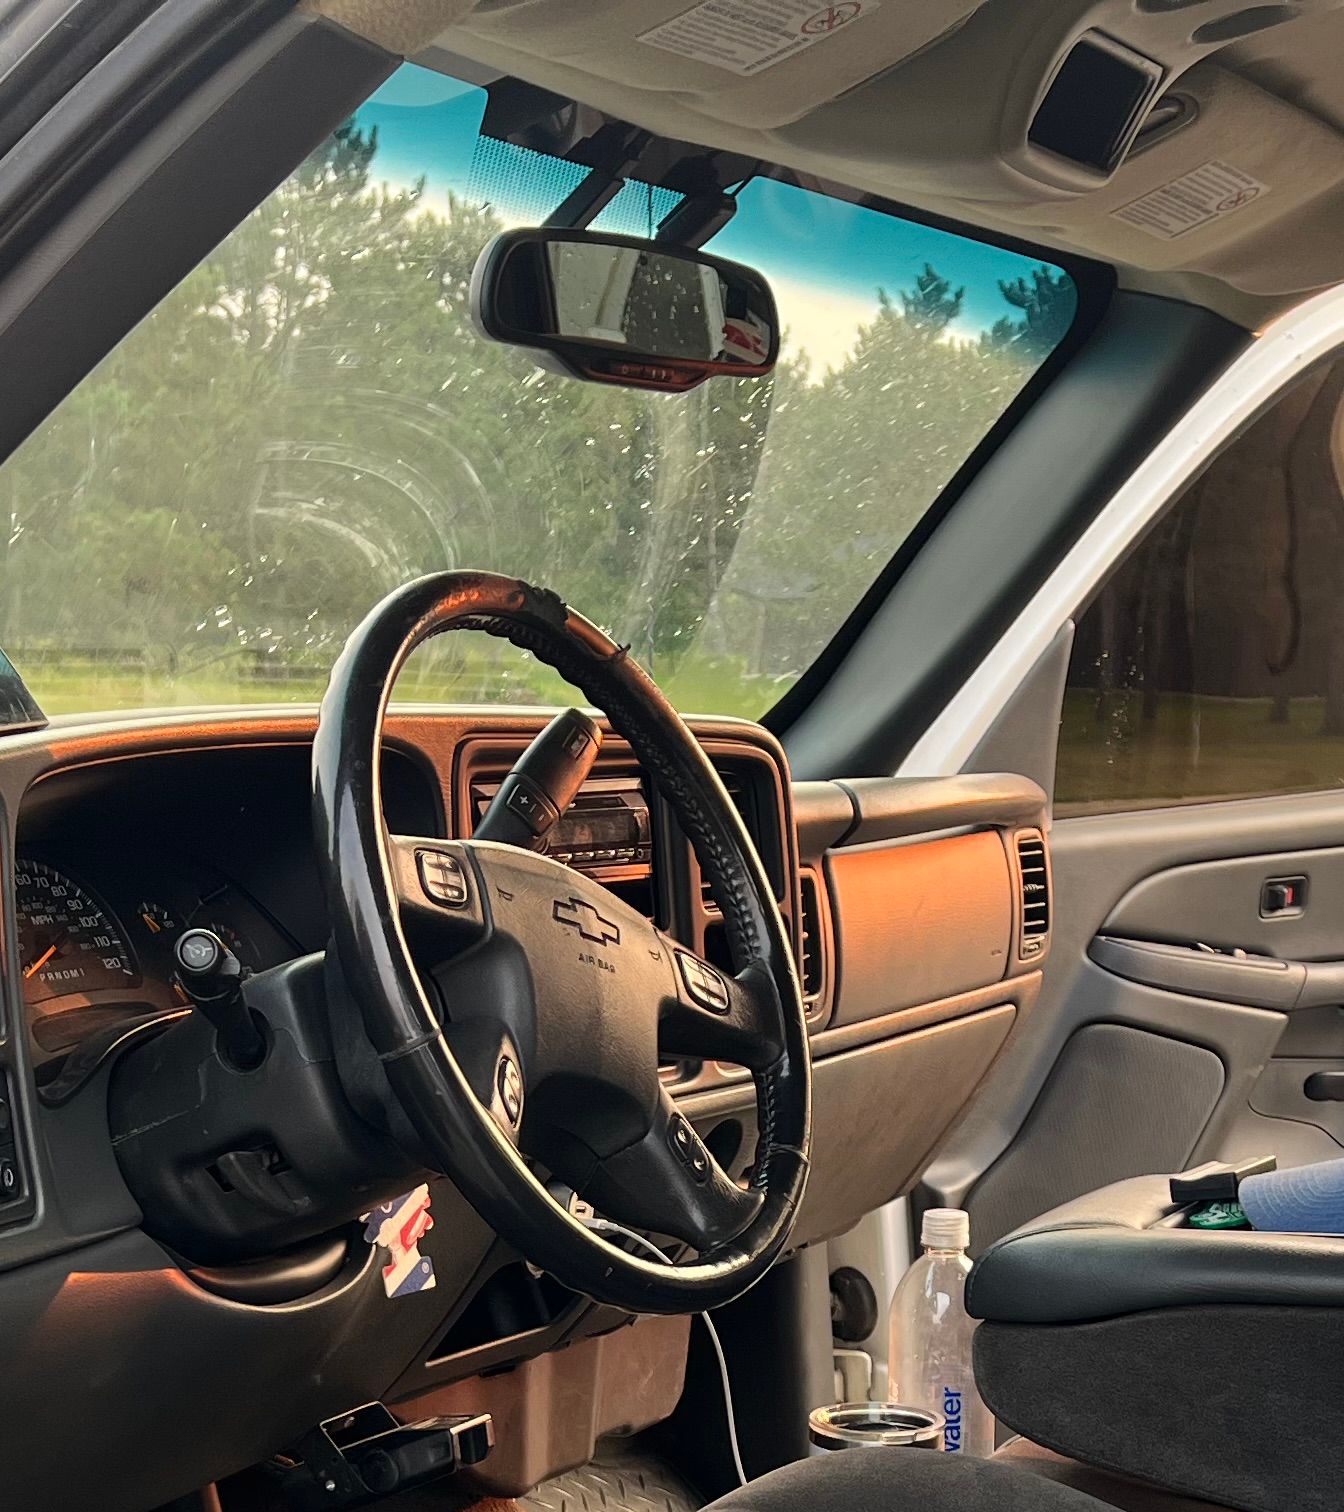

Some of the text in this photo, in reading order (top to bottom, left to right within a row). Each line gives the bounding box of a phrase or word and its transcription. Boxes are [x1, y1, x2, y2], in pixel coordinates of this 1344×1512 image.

[16, 874, 31, 886] 60
[33, 876, 50, 889] 70
[51, 886, 67, 897] 80
[67, 900, 83, 911] 90
[30, 914, 54, 925] MPH
[78, 915, 98, 928] 100
[93, 935, 111, 948] 110
[102, 957, 122, 969] 120
